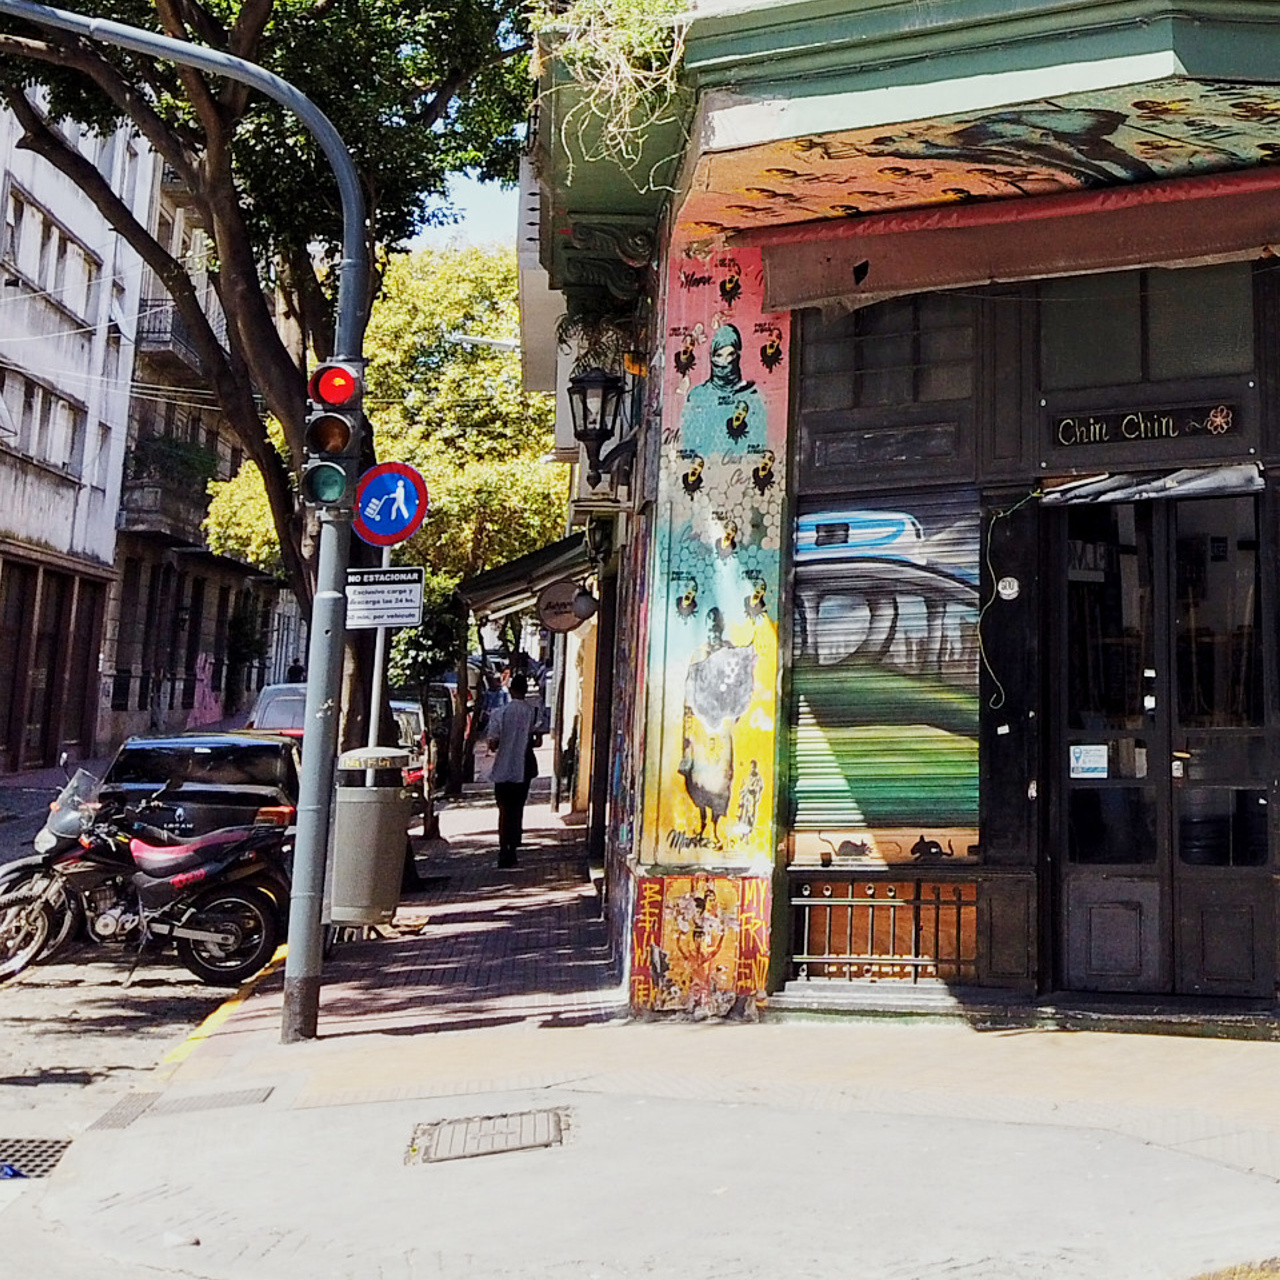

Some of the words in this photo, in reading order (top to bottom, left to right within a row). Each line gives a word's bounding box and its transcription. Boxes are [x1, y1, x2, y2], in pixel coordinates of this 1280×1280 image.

[1058, 417, 1110, 446] Chin
[1121, 411, 1179, 439] Chin
[347, 574, 362, 583] NO
[363, 572, 419, 583] ESTACIONAR
